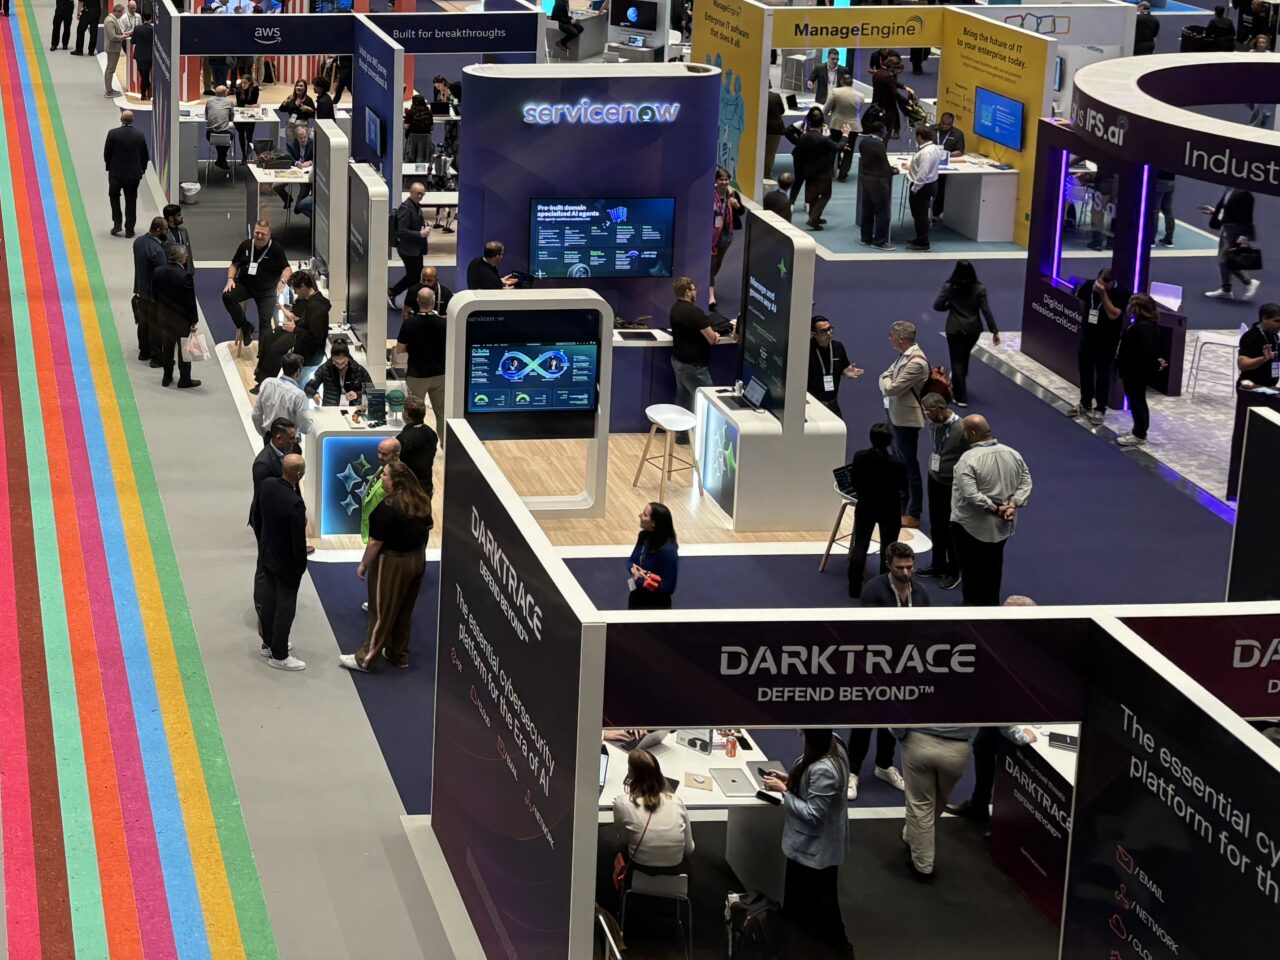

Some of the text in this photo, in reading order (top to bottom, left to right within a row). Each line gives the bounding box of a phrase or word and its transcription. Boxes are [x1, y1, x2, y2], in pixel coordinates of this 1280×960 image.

[254, 27, 281, 37] aws
[393, 26, 507, 42] Built for breakthroughs
[704, 11, 750, 40] Enterprise software
[793, 20, 916, 40] ManageEngine
[963, 26, 1023, 54] Bring the future of IT
[957, 37, 963, 47] to
[964, 40, 977, 53] your
[977, 45, 1007, 64] enterprise
[1008, 54, 1027, 70] today.
[523, 97, 681, 125] servicenow
[1085, 108, 1125, 147] IFS.ai
[1031, 302, 1078, 334] mission-critical
[1042, 293, 1063, 314] Digital
[471, 504, 543, 641] DARKTRACE
[479, 559, 500, 603] DEFEND
[720, 643, 977, 677] DARKTRACE
[455, 582, 555, 778] The essential cybersecurity
[757, 684, 935, 703] DEFEND BEYOND™
[458, 622, 550, 798] platform for the Era of AI
[1120, 703, 1252, 840] The essential
[1129, 754, 1213, 845] platform
[1218, 832, 1250, 875] for
[1138, 869, 1166, 905] EMAIL
[1135, 902, 1180, 956] NETWORK
